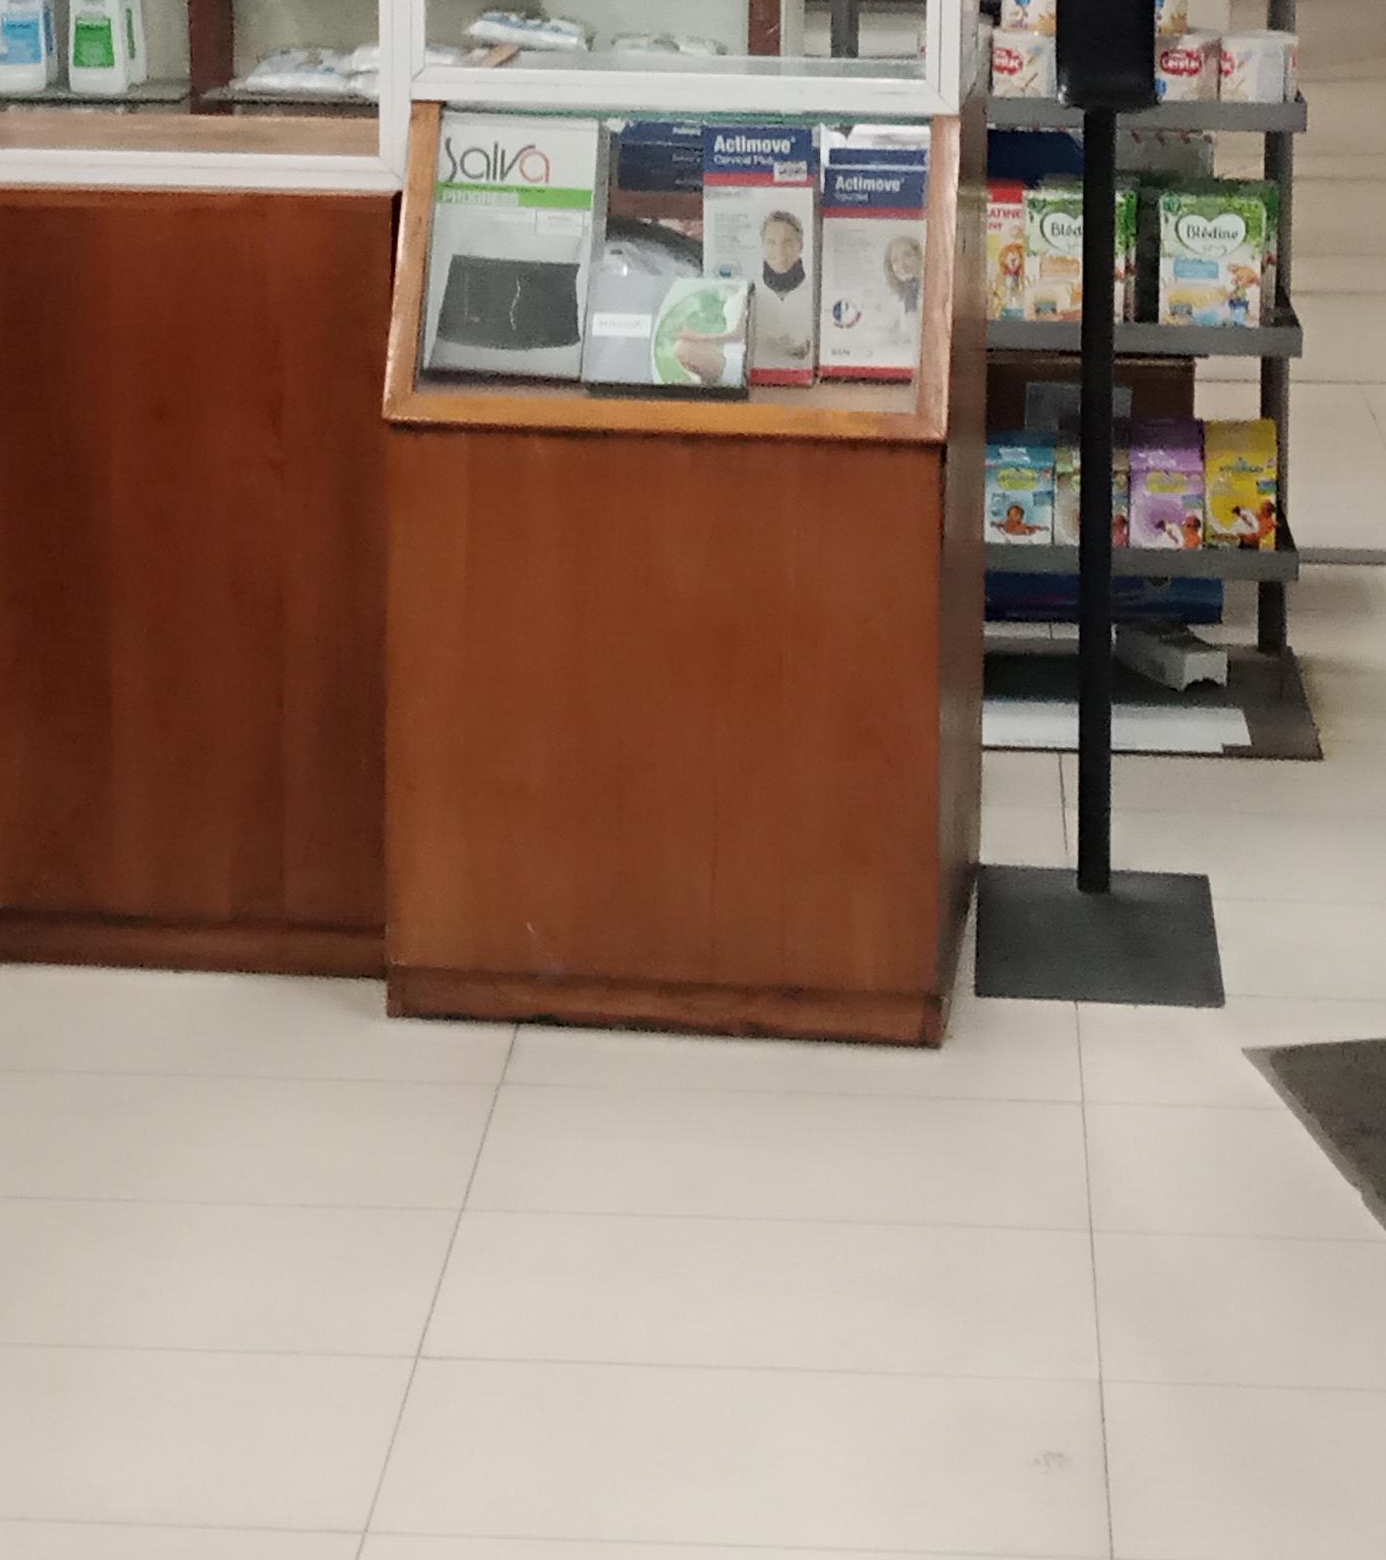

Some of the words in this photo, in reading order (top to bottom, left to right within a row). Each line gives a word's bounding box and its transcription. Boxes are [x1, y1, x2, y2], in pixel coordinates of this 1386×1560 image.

[713, 134, 792, 154] Actimove
[835, 175, 901, 192] Actimove
[1051, 220, 1083, 237] Bléd
[1186, 223, 1239, 241] Blédine
